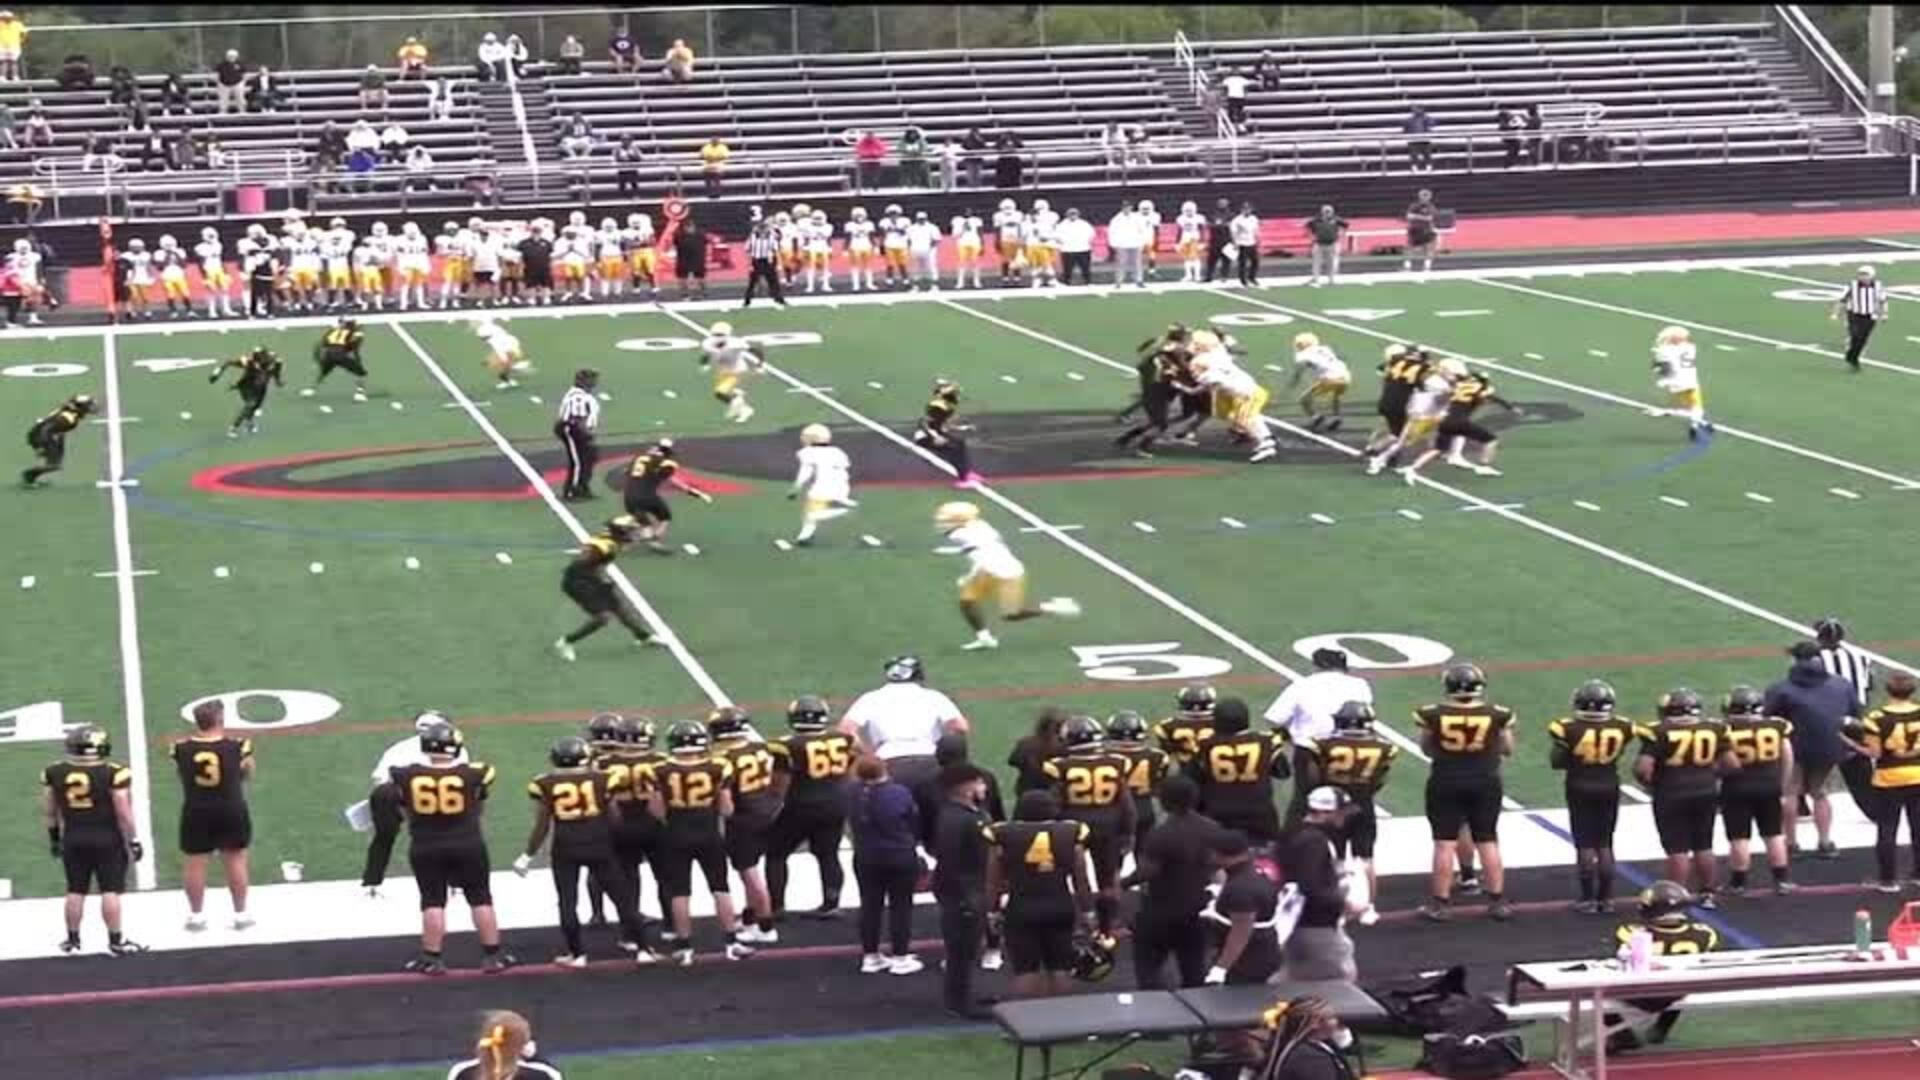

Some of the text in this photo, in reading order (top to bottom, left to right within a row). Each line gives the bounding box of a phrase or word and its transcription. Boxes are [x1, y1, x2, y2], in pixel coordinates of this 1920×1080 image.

[750, 205, 762, 221] 3
[1071, 641, 1232, 681] 5
[1440, 715, 1491, 752] 57
[1572, 728, 1624, 766] 40
[1667, 729, 1717, 767] 70
[1730, 727, 1781, 766] 58
[193, 752, 221, 788] 3
[805, 737, 849, 778] 65
[1210, 742, 1261, 782] 67
[1329, 747, 1382, 783] 27
[65, 772, 93, 809] 2
[411, 776, 465, 814] 66
[552, 780, 600, 820] 21
[668, 771, 713, 808] 12
[1066, 765, 1118, 805] 26
[1025, 831, 1054, 872] 4
